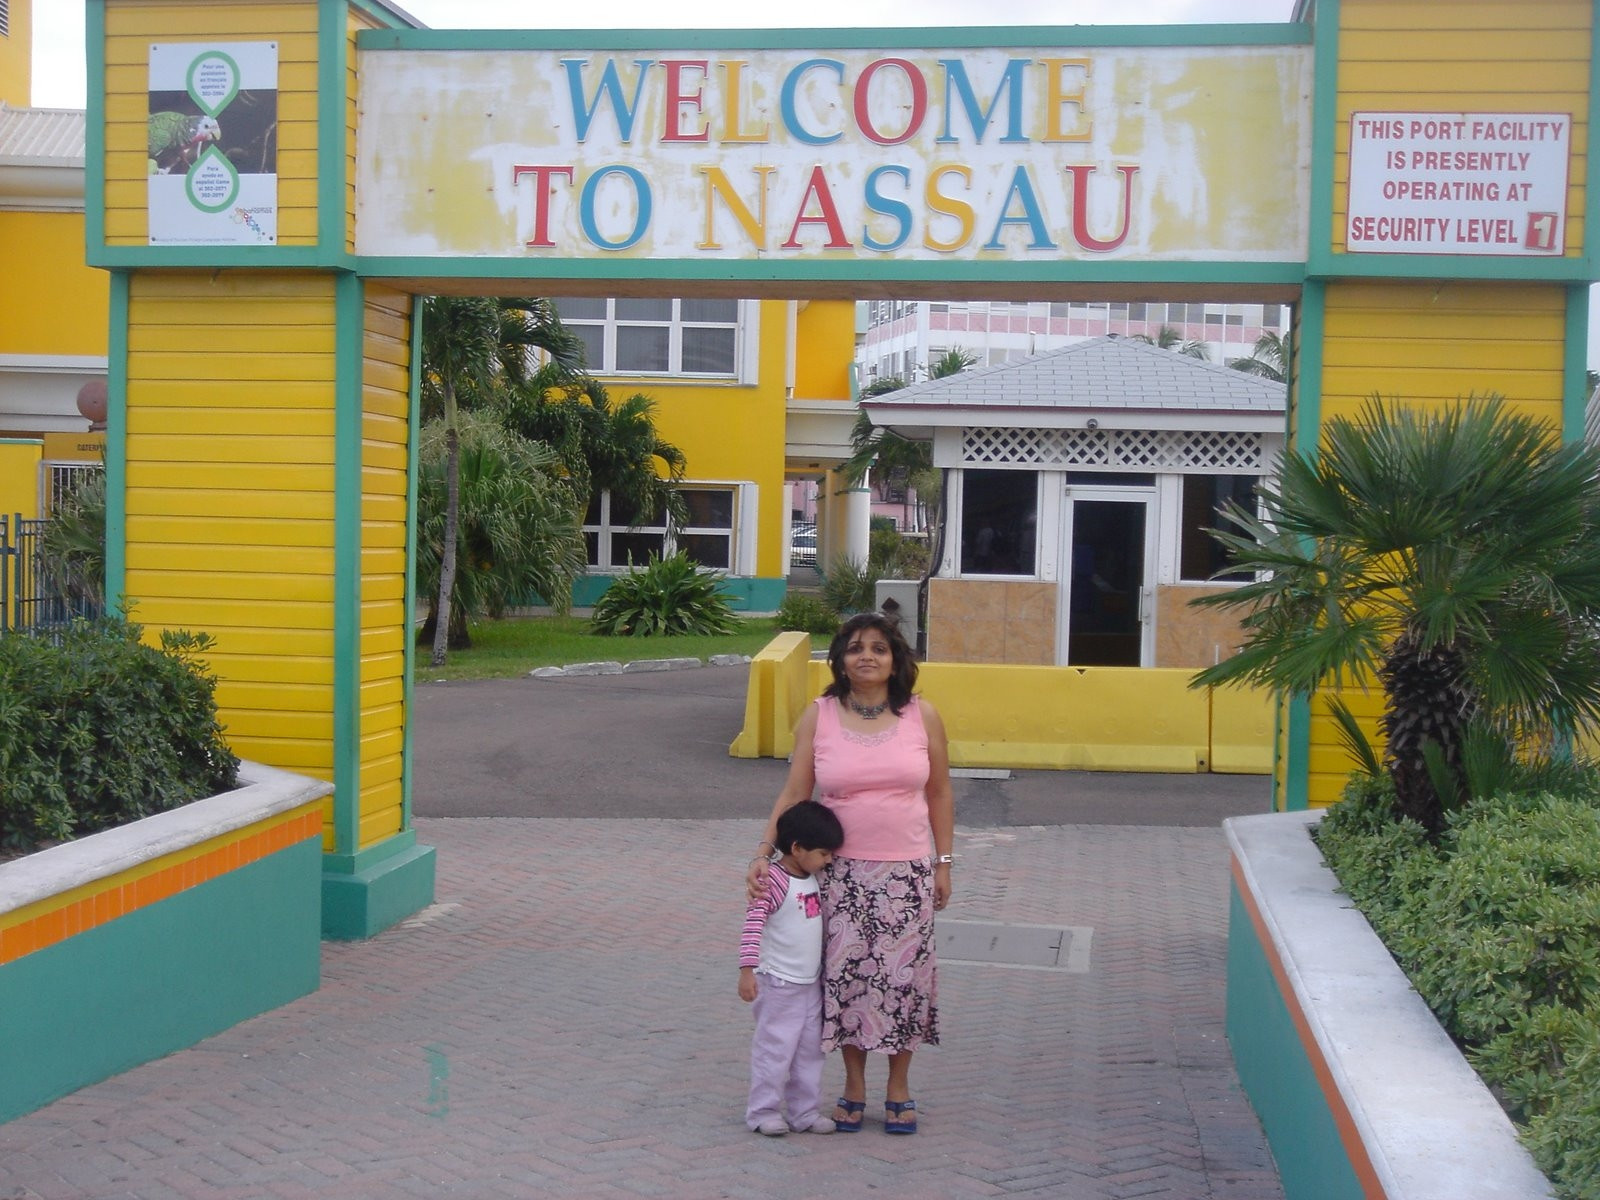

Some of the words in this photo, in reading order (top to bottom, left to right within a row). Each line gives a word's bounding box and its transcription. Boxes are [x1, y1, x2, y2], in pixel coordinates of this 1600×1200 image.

[559, 57, 1094, 147] WELCOME
[1358, 120, 1404, 140] THIS
[1410, 121, 1466, 140] PORT
[1472, 121, 1563, 141] FACILITY
[1386, 151, 1406, 170] IS
[1412, 151, 1531, 171] PRESENTLY
[1382, 181, 1500, 201] OPERATING
[1506, 183, 1533, 201] AT
[513, 164, 653, 251] TO
[697, 162, 1140, 253] NASSAU
[1351, 216, 1450, 242] SECURITY
[1456, 218, 1518, 243] LEVEL
[1533, 215, 1553, 248] 1
